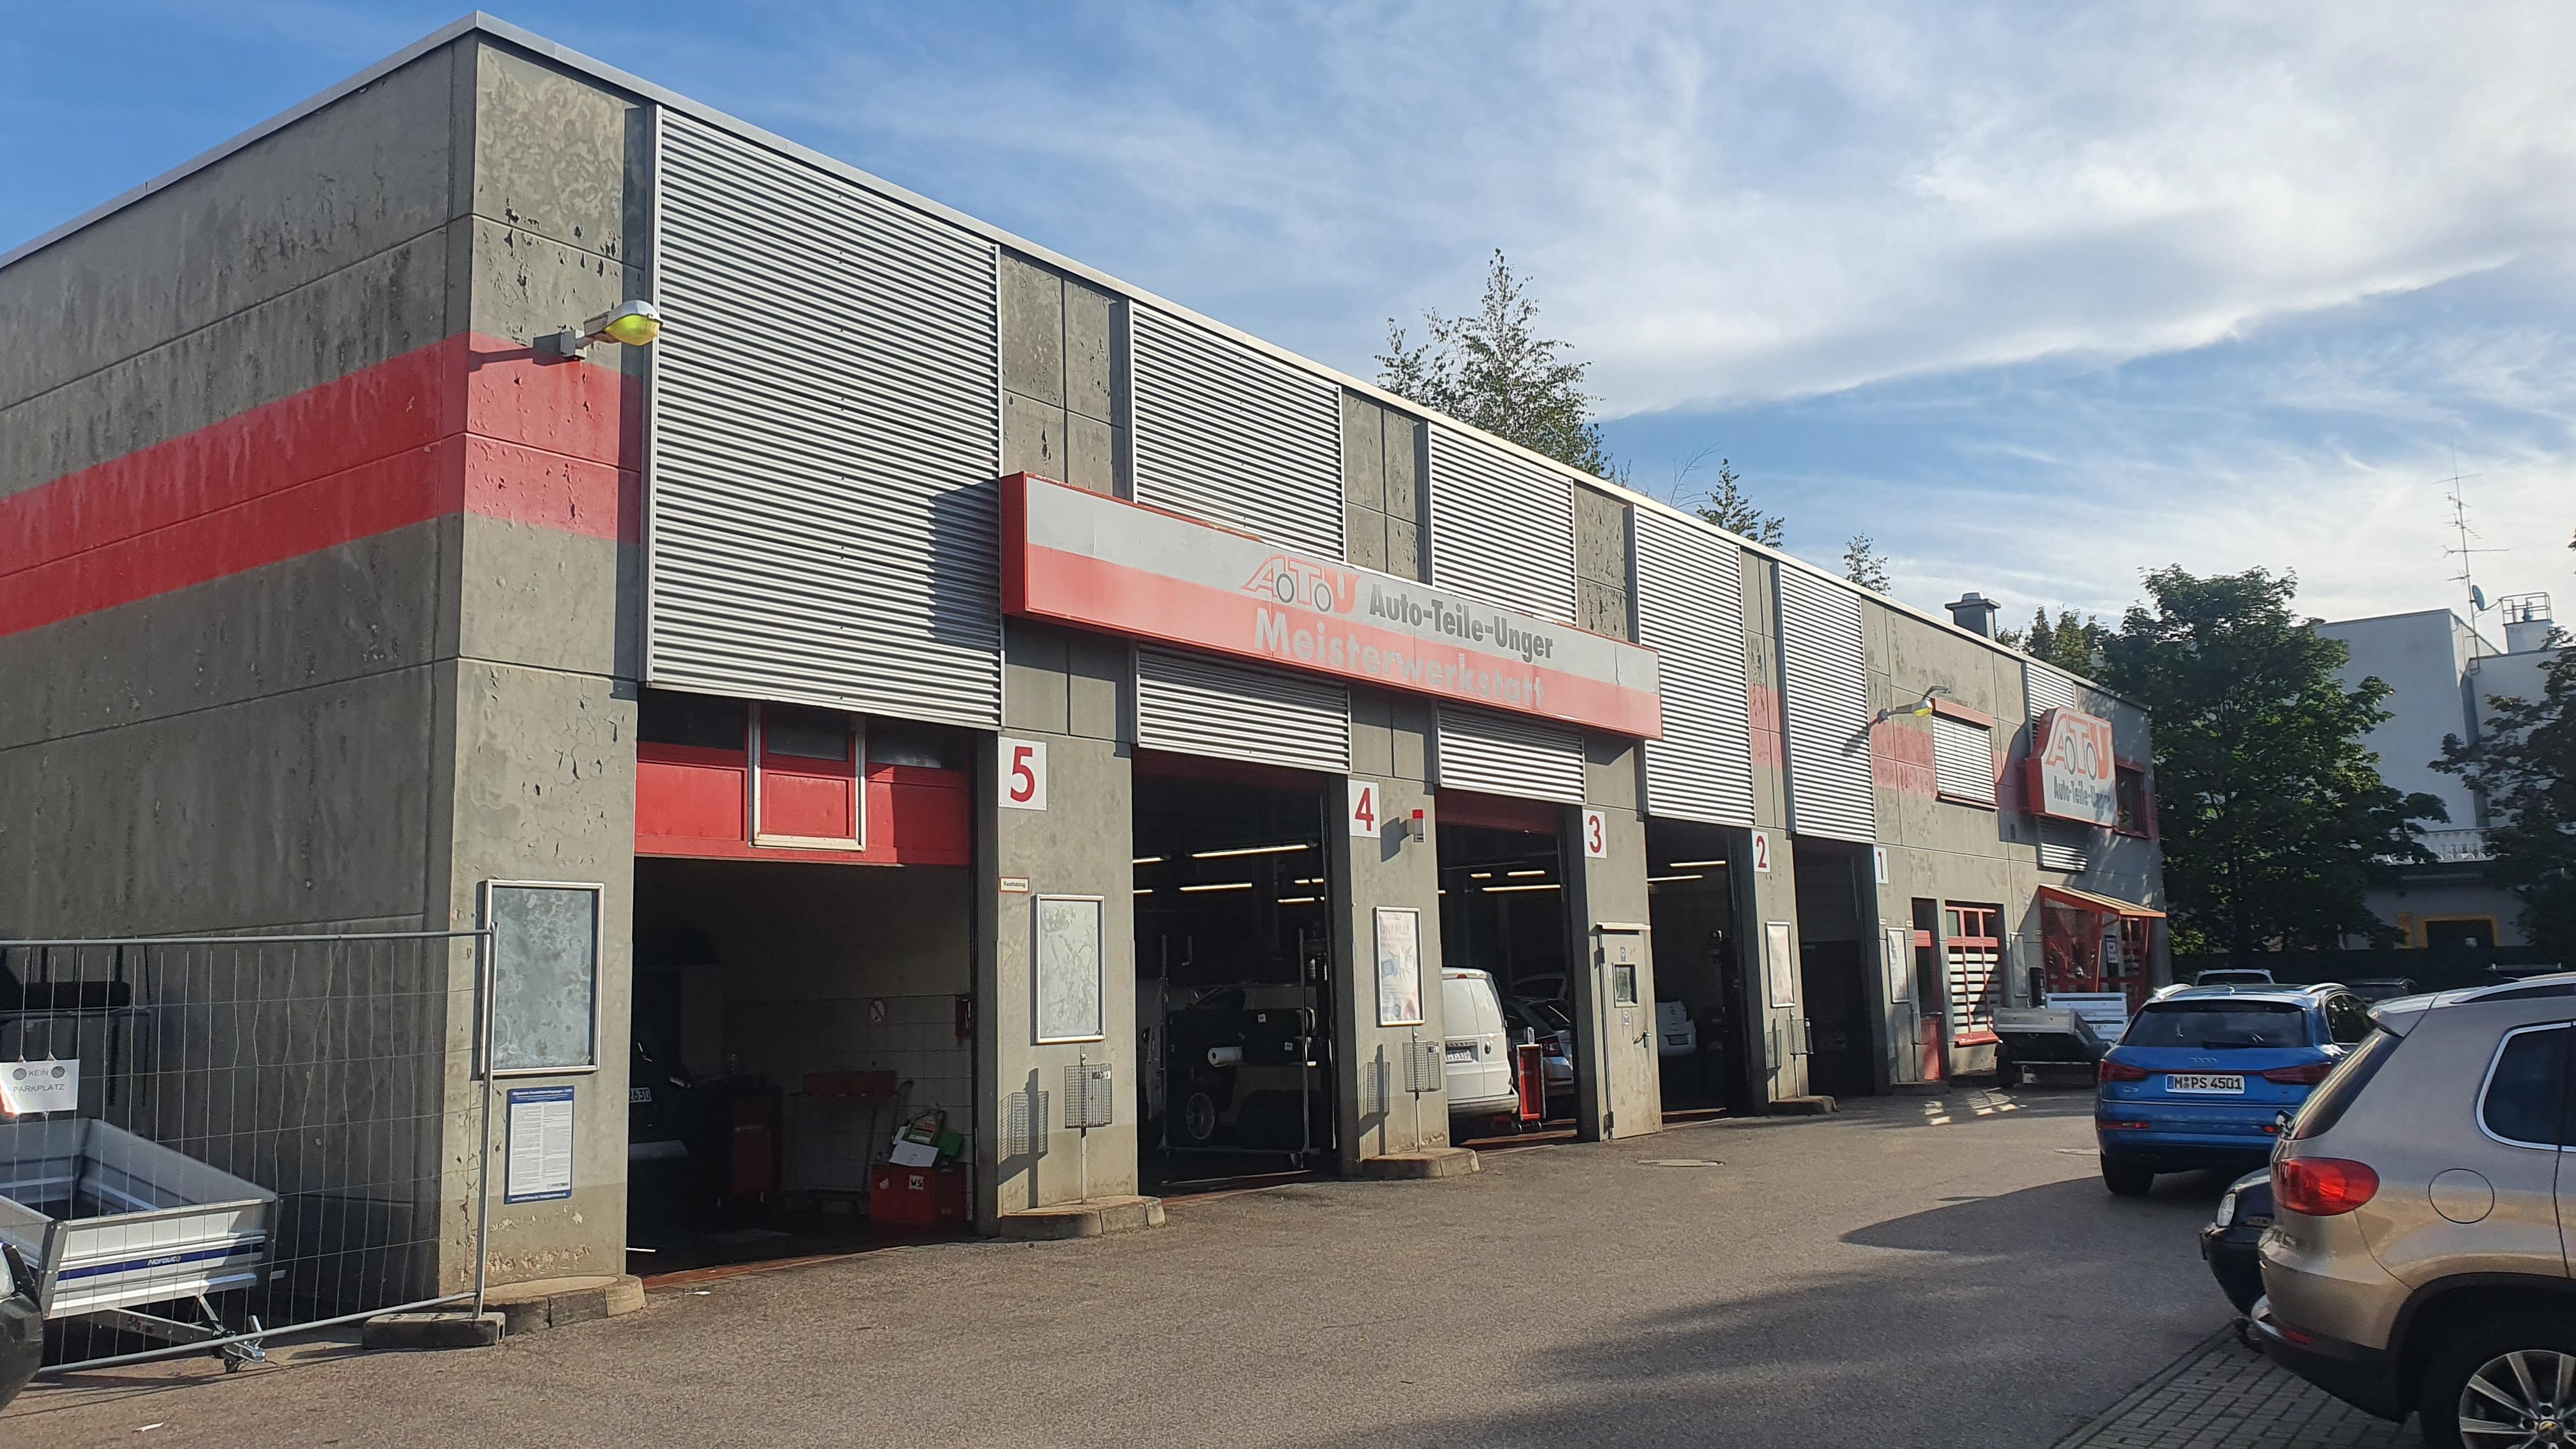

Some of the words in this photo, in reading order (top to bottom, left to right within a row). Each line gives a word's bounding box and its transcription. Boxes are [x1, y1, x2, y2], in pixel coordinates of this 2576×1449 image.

[1369, 583, 1553, 663] Auto-Teile-Unger
[1254, 607, 1544, 707] Meisterwerkstatt
[1010, 746, 1035, 802] 5
[1354, 787, 1374, 832] 4
[1589, 815, 1602, 854] 3
[1756, 835, 1767, 869] 2
[1878, 851, 1884, 880] 1
[13, 1084, 65, 1092] PARKPLATZ
[2209, 1077, 2243, 1090] 4501
